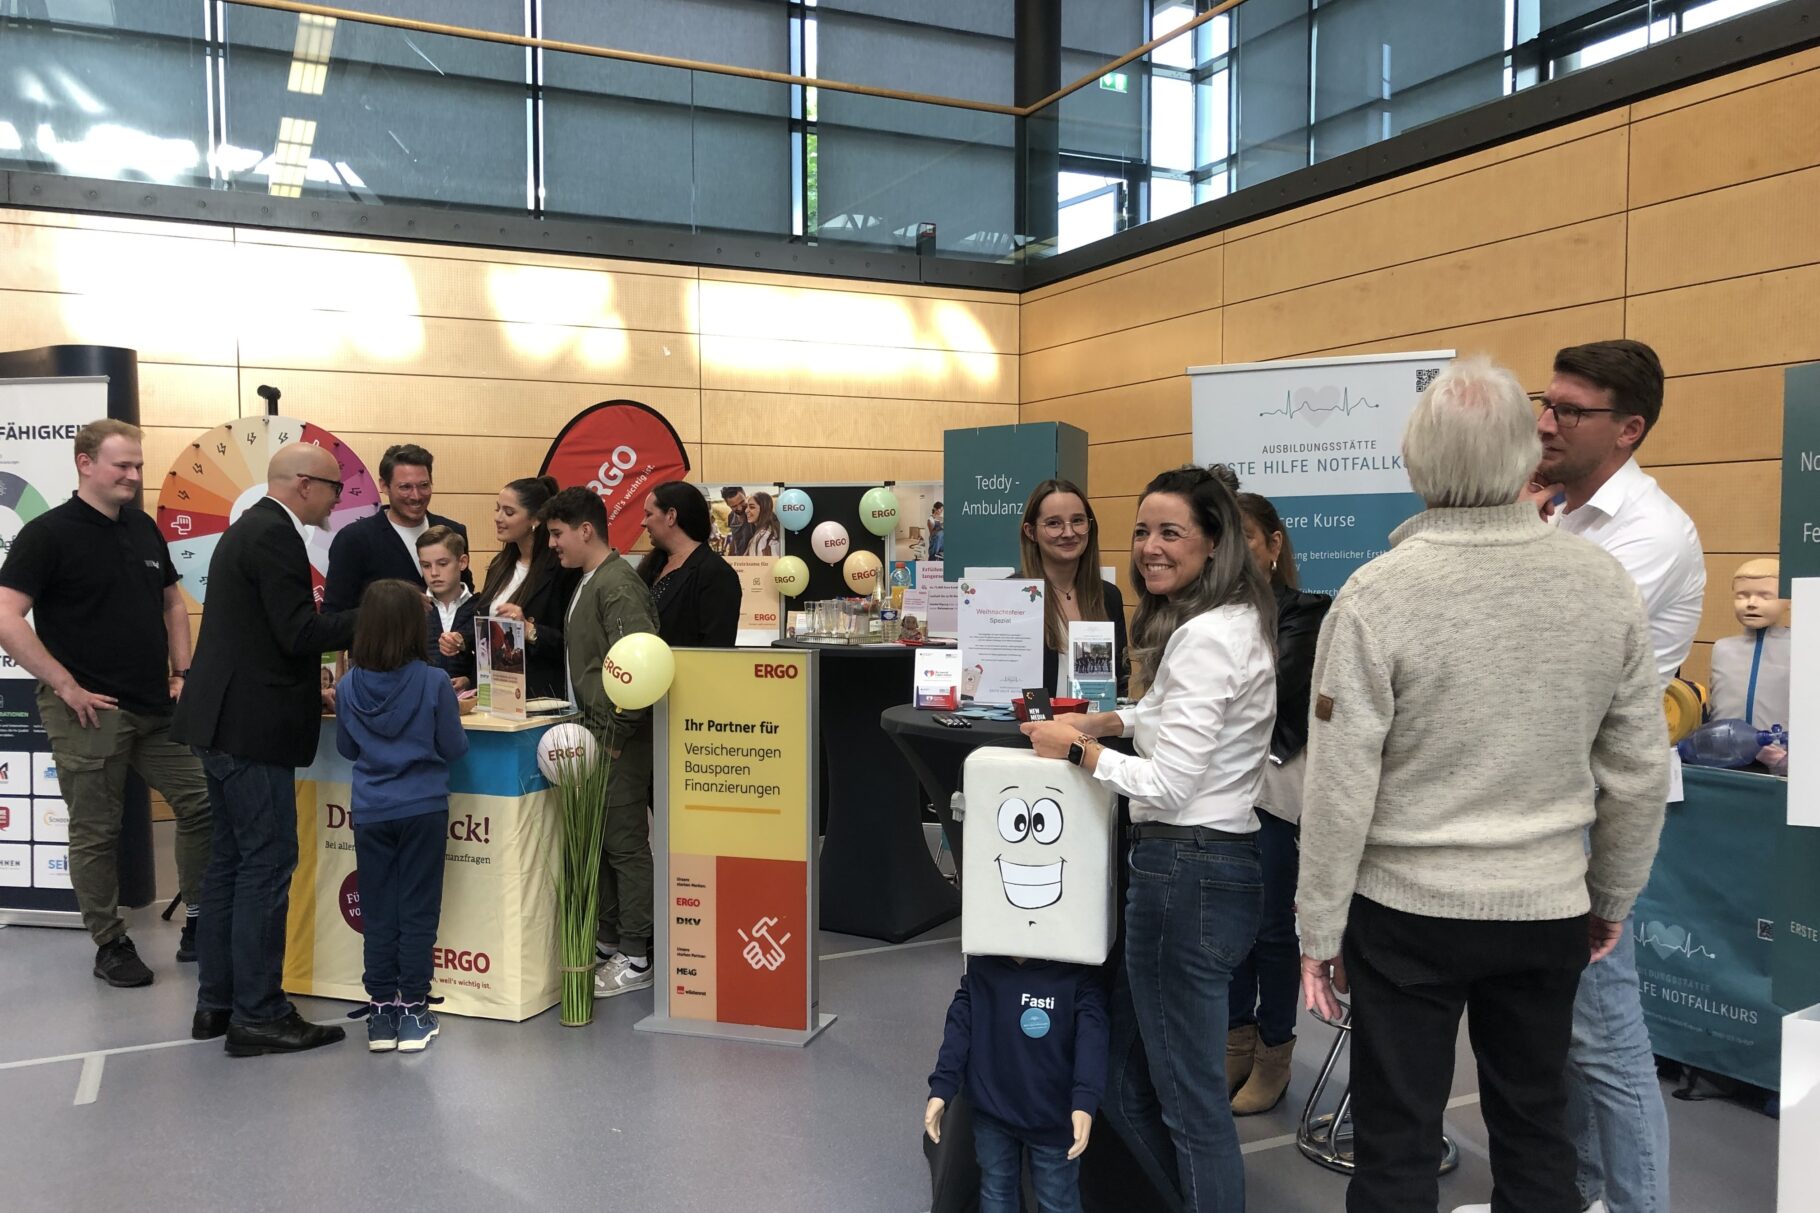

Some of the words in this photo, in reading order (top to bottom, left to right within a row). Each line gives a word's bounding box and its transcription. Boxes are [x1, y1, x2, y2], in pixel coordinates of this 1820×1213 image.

[1262, 440, 1377, 454] AUSBILDUNGSSTÄTTE
[1264, 459, 1309, 474] HILFE
[1317, 456, 1408, 473] NOTFALLK
[624, 474, 648, 500] wichtig
[975, 473, 1012, 493] Teddy
[783, 504, 805, 512] ERGO
[872, 508, 896, 518] ERGO
[962, 499, 1024, 515] Ambulanz
[1314, 513, 1356, 528] Kurse
[825, 538, 847, 548] ERGO
[1310, 550, 1364, 560] betrieblicher
[774, 575, 795, 584] ERGO
[852, 570, 876, 581] ERGO
[754, 613, 776, 621] ERGO
[603, 656, 632, 684] ERGO
[755, 664, 798, 679] ERGO
[684, 719, 704, 731] Ihr
[707, 720, 756, 734] Partner
[759, 721, 779, 734] für
[548, 746, 584, 761] ERGO
[684, 742, 781, 761] Versicherungen
[684, 761, 750, 777] Bausparen
[684, 779, 780, 798] Finanzierungen
[446, 814, 490, 844] ck!
[325, 841, 336, 849] Bei
[676, 898, 700, 907] ERGO
[676, 917, 701, 926] DKV
[1791, 921, 1818, 942] ERSTE
[432, 947, 490, 973] ERGO
[439, 977, 457, 985] weil's
[458, 980, 480, 989] wichtig
[1021, 993, 1055, 1010] Fasti
[1662, 987, 1758, 1025] NOTFALLKURS
